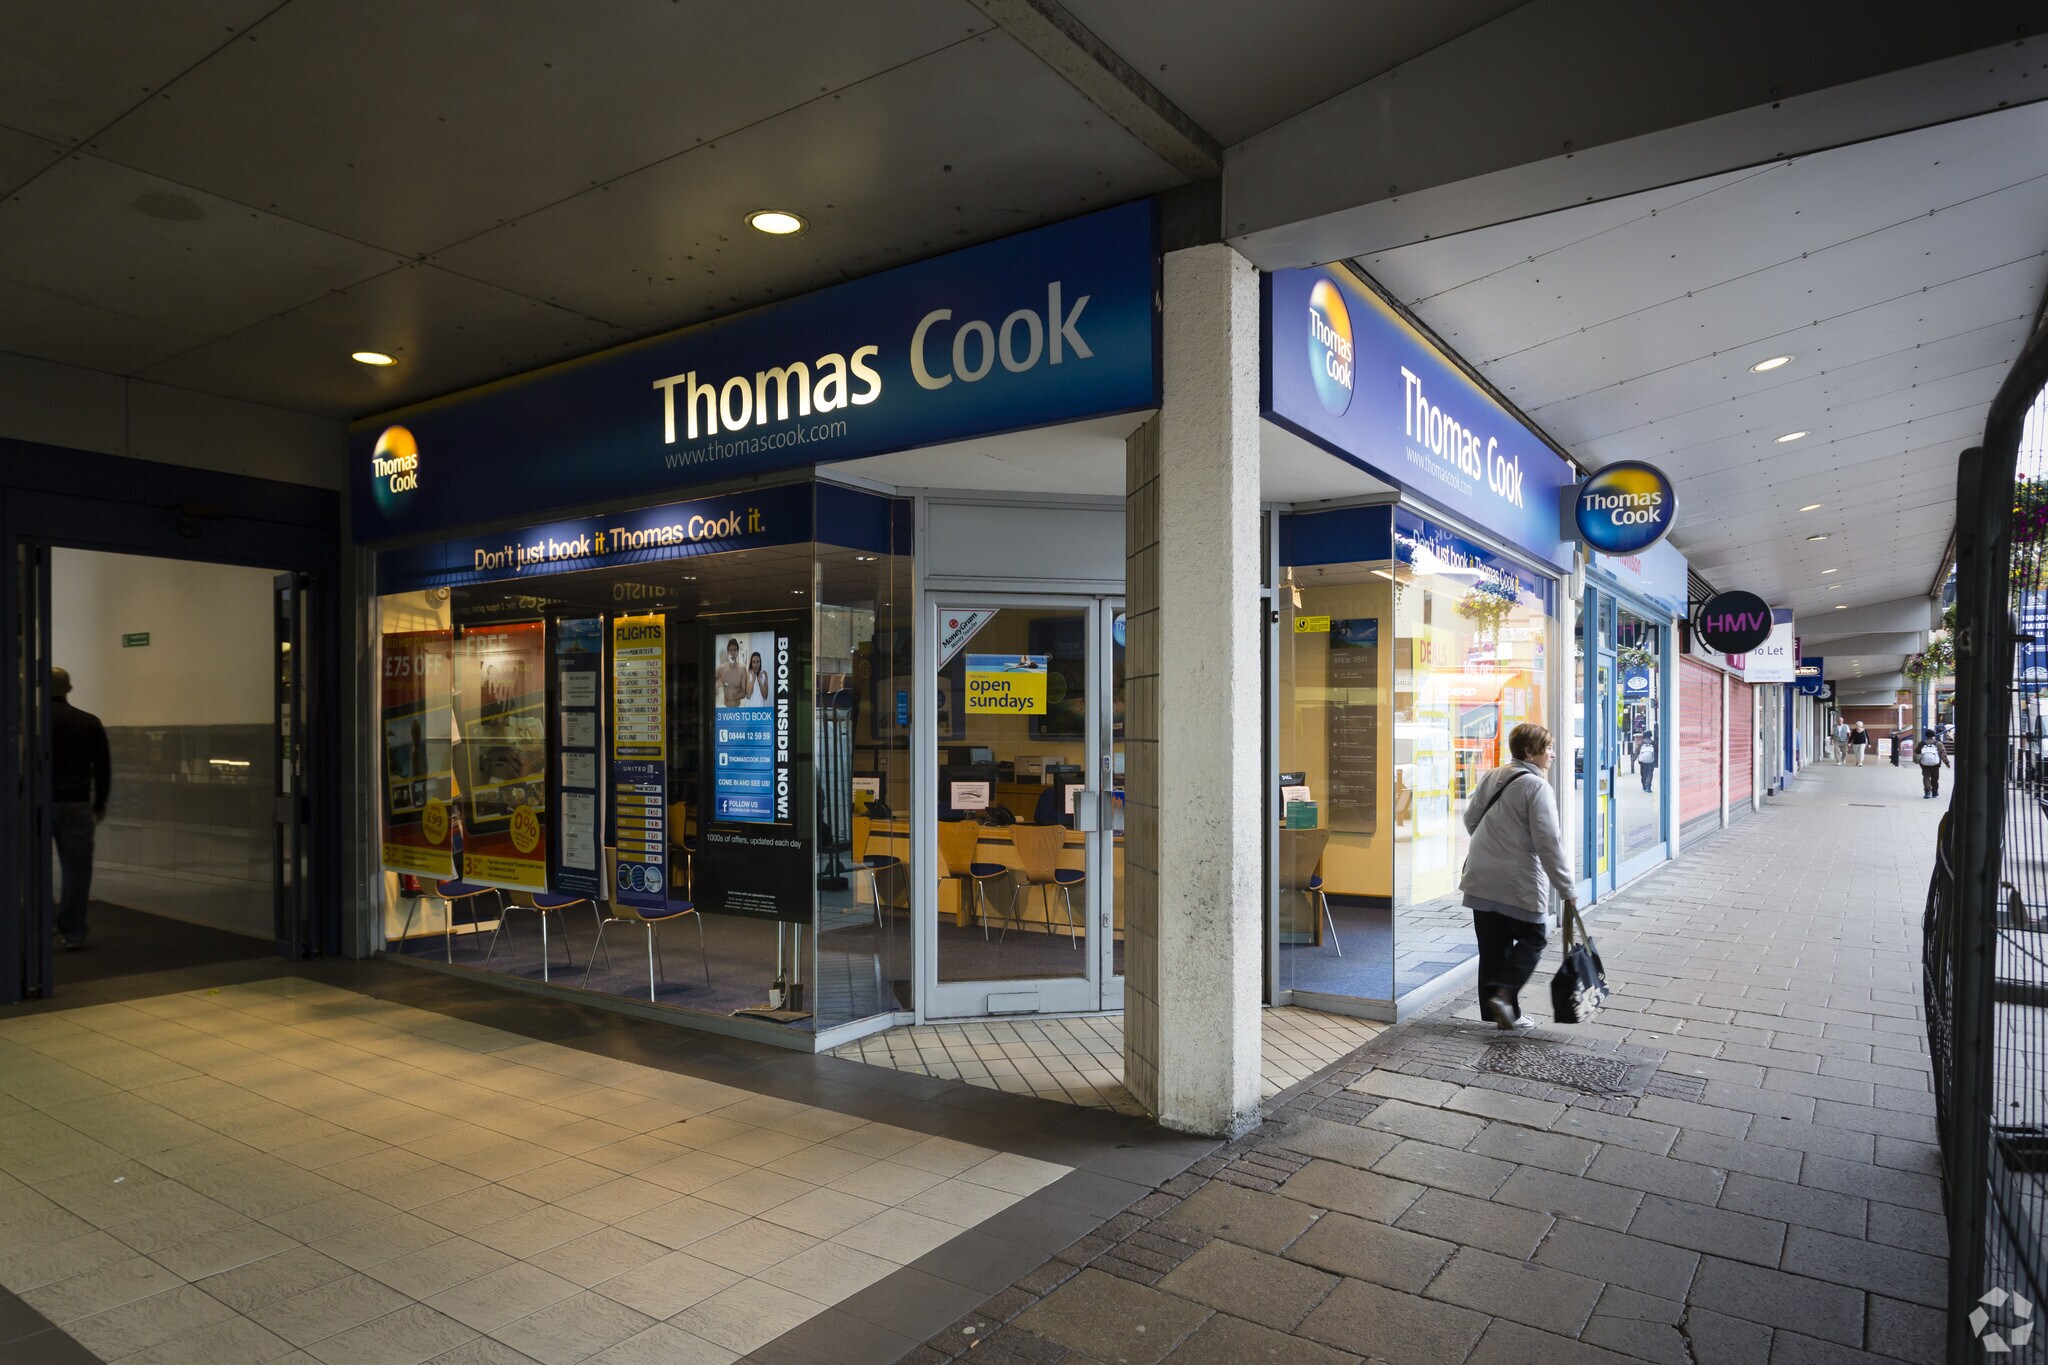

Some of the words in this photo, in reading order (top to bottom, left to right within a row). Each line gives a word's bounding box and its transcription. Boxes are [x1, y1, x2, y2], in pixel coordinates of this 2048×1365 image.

[1309, 308, 1351, 364] Thomas
[653, 345, 883, 444] Thomas
[910, 280, 1095, 391] Cook
[1326, 350, 1351, 390] Cook
[664, 418, 847, 470] www.thomascook.com
[1401, 365, 1482, 482] Thomas
[1487, 436, 1523, 509] Cook
[372, 454, 418, 478] Thomas
[1406, 446, 1473, 498] www.thomascook.com
[390, 470, 418, 493] Cook
[1583, 492, 1662, 511] Thomas
[1611, 506, 1661, 526] Cook
[475, 545, 513, 571] Don't
[517, 541, 544, 572] just
[549, 534, 590, 561] book
[609, 525, 683, 551] Thomas
[688, 511, 741, 541] Cook
[748, 508, 766, 534] it.
[1450, 546, 1468, 569] book
[1500, 568, 1515, 591] Cook
[616, 626, 661, 640] FLIGHTS
[942, 612, 977, 648] MoneyGram
[1707, 612, 1764, 633] HMV
[466, 634, 508, 660] FREE
[951, 636, 964, 649] Money
[962, 621, 978, 637] Transfer
[1354, 655, 1368, 663] 1841
[1420, 640, 1448, 666] DEALS
[1767, 646, 1784, 656] Let
[385, 655, 410, 677] £75
[414, 655, 442, 676] OFF
[777, 637, 788, 693] BOOK
[970, 680, 1011, 695] open
[970, 694, 1034, 711] sundays
[718, 712, 721, 721] 3
[722, 712, 740, 721] WAYS
[741, 712, 751, 721] TO
[752, 712, 772, 721] BOOK
[729, 732, 745, 740] 08444
[747, 732, 753, 740] 12
[755, 732, 762, 740] 59
[763, 732, 771, 740] 59
[777, 699, 788, 762] INSIDE
[729, 800, 750, 808] FOLLOW
[777, 768, 788, 819] NOW!
[427, 812, 442, 827] £99
[515, 812, 536, 837] 0%
[707, 834, 723, 842] 1000s
[731, 836, 749, 845] offers,
[750, 838, 774, 846] updated
[790, 841, 801, 849] day
[465, 857, 472, 875] 3
